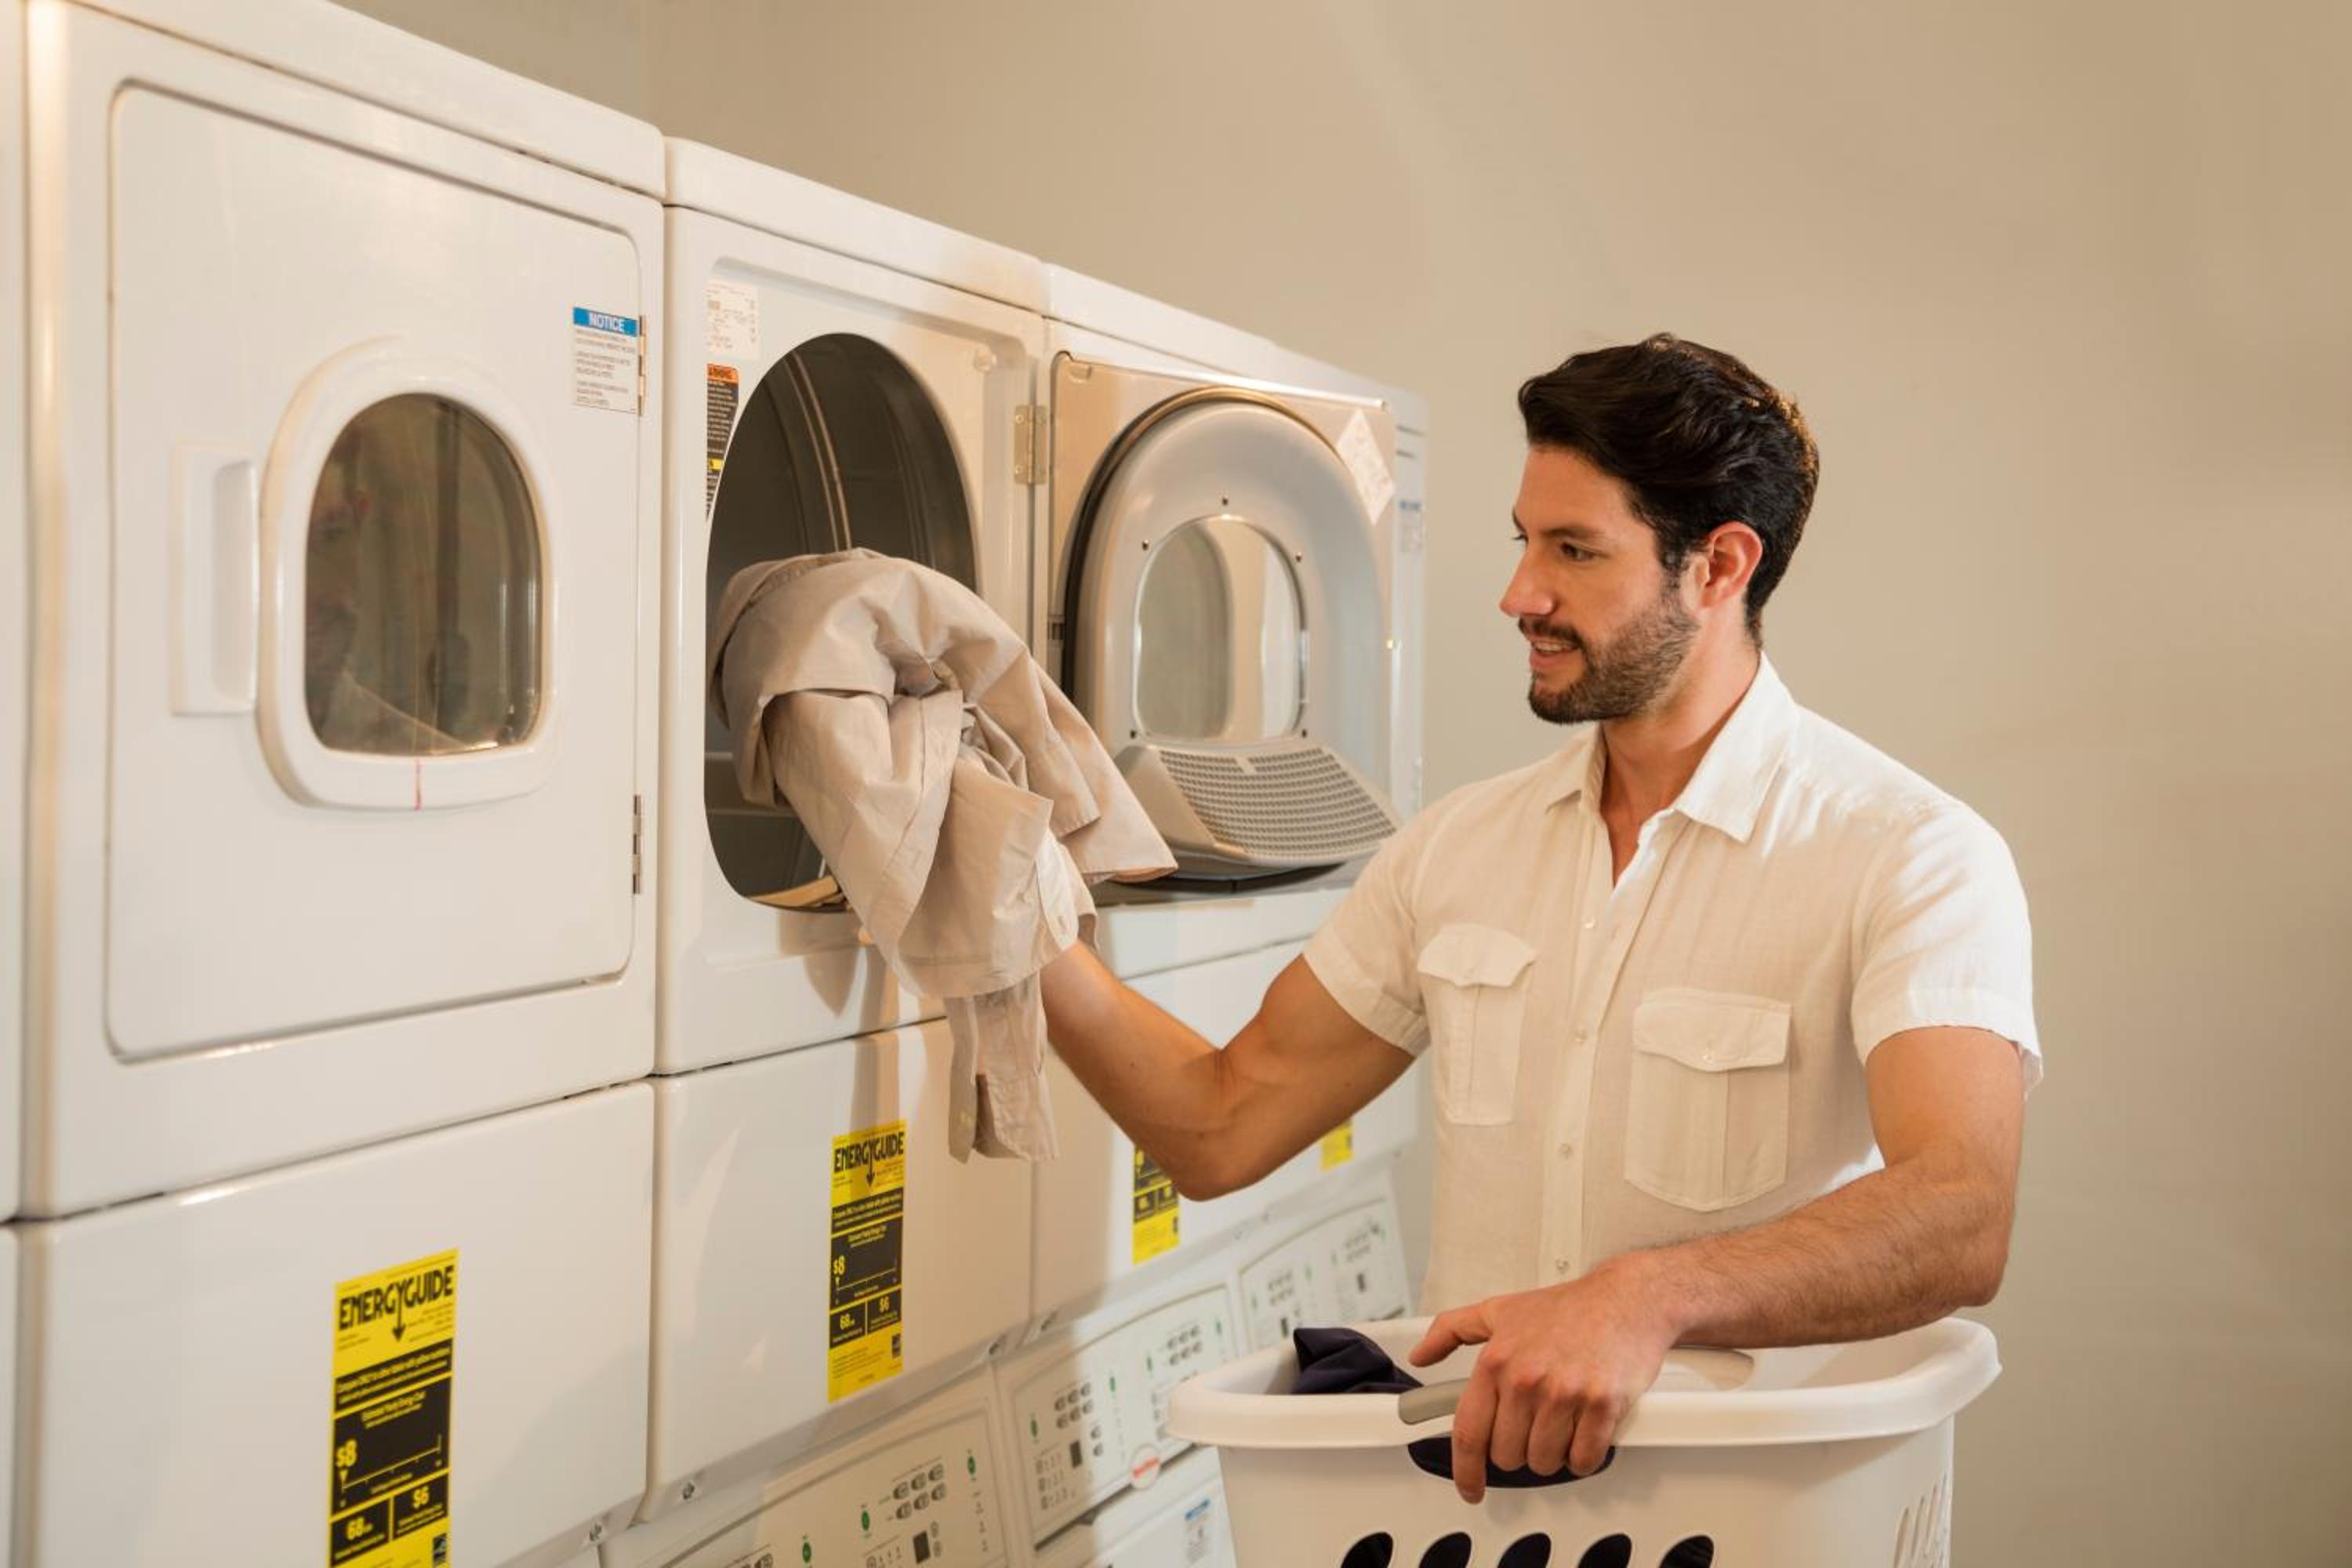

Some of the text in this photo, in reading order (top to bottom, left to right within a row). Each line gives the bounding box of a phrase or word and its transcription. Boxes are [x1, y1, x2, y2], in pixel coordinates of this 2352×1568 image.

[589, 311, 626, 332] NOTICE
[833, 1132, 904, 1174] ENERGYGUIDE
[339, 1264, 454, 1330] ENERGYGUIDE
